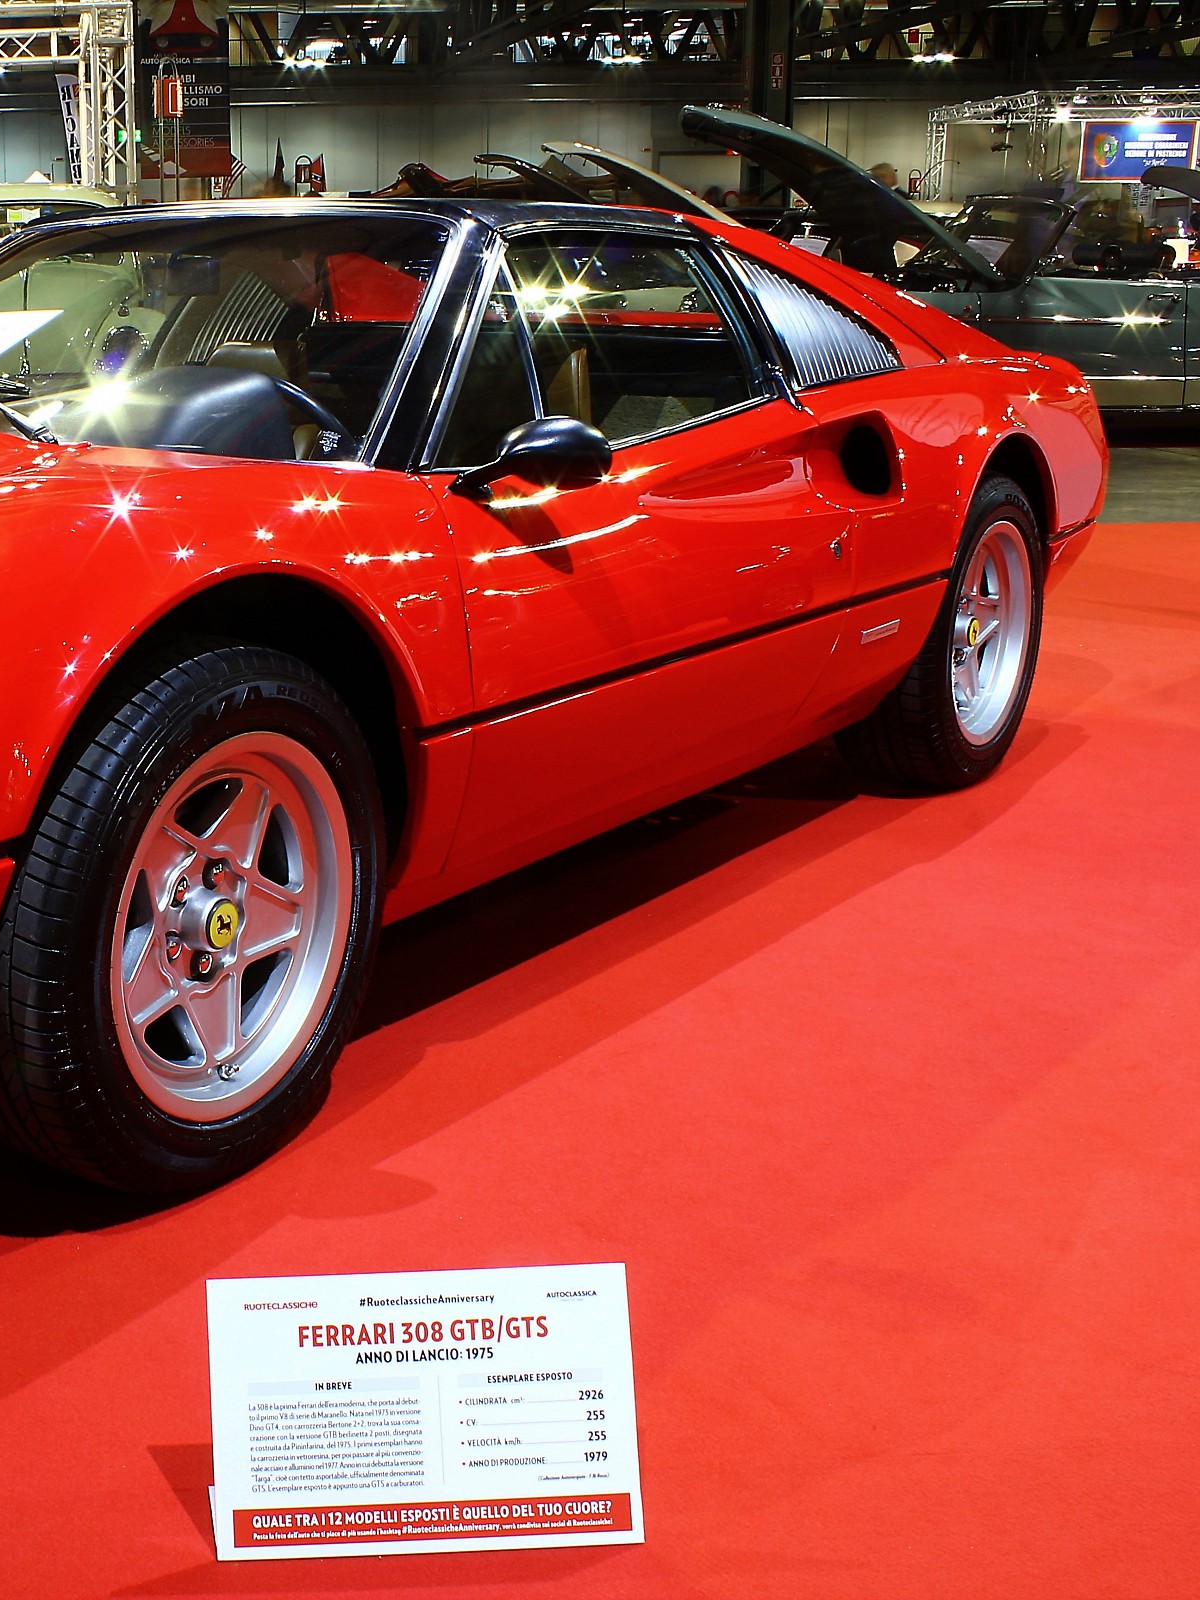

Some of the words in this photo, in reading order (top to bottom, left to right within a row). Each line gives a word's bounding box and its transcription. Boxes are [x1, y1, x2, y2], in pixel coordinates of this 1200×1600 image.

[359, 1293, 495, 1307] #RuoteclassicheAnniversary
[546, 1290, 598, 1298] AUTOCLASSICA
[298, 1322, 395, 1348] FERRARI
[401, 1320, 444, 1344] 308
[450, 1315, 548, 1343] GTB/GTS
[355, 1351, 393, 1364] ANNO
[396, 1350, 409, 1363] DI
[412, 1348, 463, 1362] LANCIO:
[466, 1347, 494, 1360] 1975
[487, 1373, 534, 1384] ESEMPLARE
[536, 1371, 573, 1382] ESPOSTO
[315, 1382, 324, 1391] IN
[326, 1381, 352, 1391] BREVE
[465, 1397, 508, 1406] CILINDRATA
[578, 1389, 604, 1401] 2926
[249, 1403, 256, 1411] La
[257, 1403, 269, 1411] 308
[280, 1403, 297, 1411] prima
[297, 1401, 317, 1409] Ferrari
[260, 1413, 278, 1422] primo
[466, 1419, 478, 1427] CV:
[587, 1410, 606, 1421] 255
[249, 1423, 264, 1431] Dino
[328, 1421, 352, 1429] Bertone
[323, 1430, 338, 1439] GTB
[467, 1436, 502, 1447] VELOCITÀ
[588, 1430, 607, 1442] 255
[255, 1443, 281, 1452] costruita
[327, 1441, 336, 1449] del
[468, 1459, 490, 1468] ANNO
[491, 1459, 499, 1467] DI
[584, 1451, 608, 1463] 1979
[371, 1479, 385, 1488] GTS
[252, 1513, 293, 1529] QUALE
[295, 1513, 319, 1527] TRA
[321, 1512, 326, 1526] I
[327, 1511, 343, 1526] 12
[345, 1510, 398, 1525] MODELLI
[401, 1507, 450, 1522] ESPOSTI
[453, 1504, 460, 1520] È
[462, 1505, 509, 1520] QUELLO
[512, 1504, 535, 1518] DEL
[536, 1502, 562, 1516] TUO
[565, 1501, 612, 1516] CUORE?
